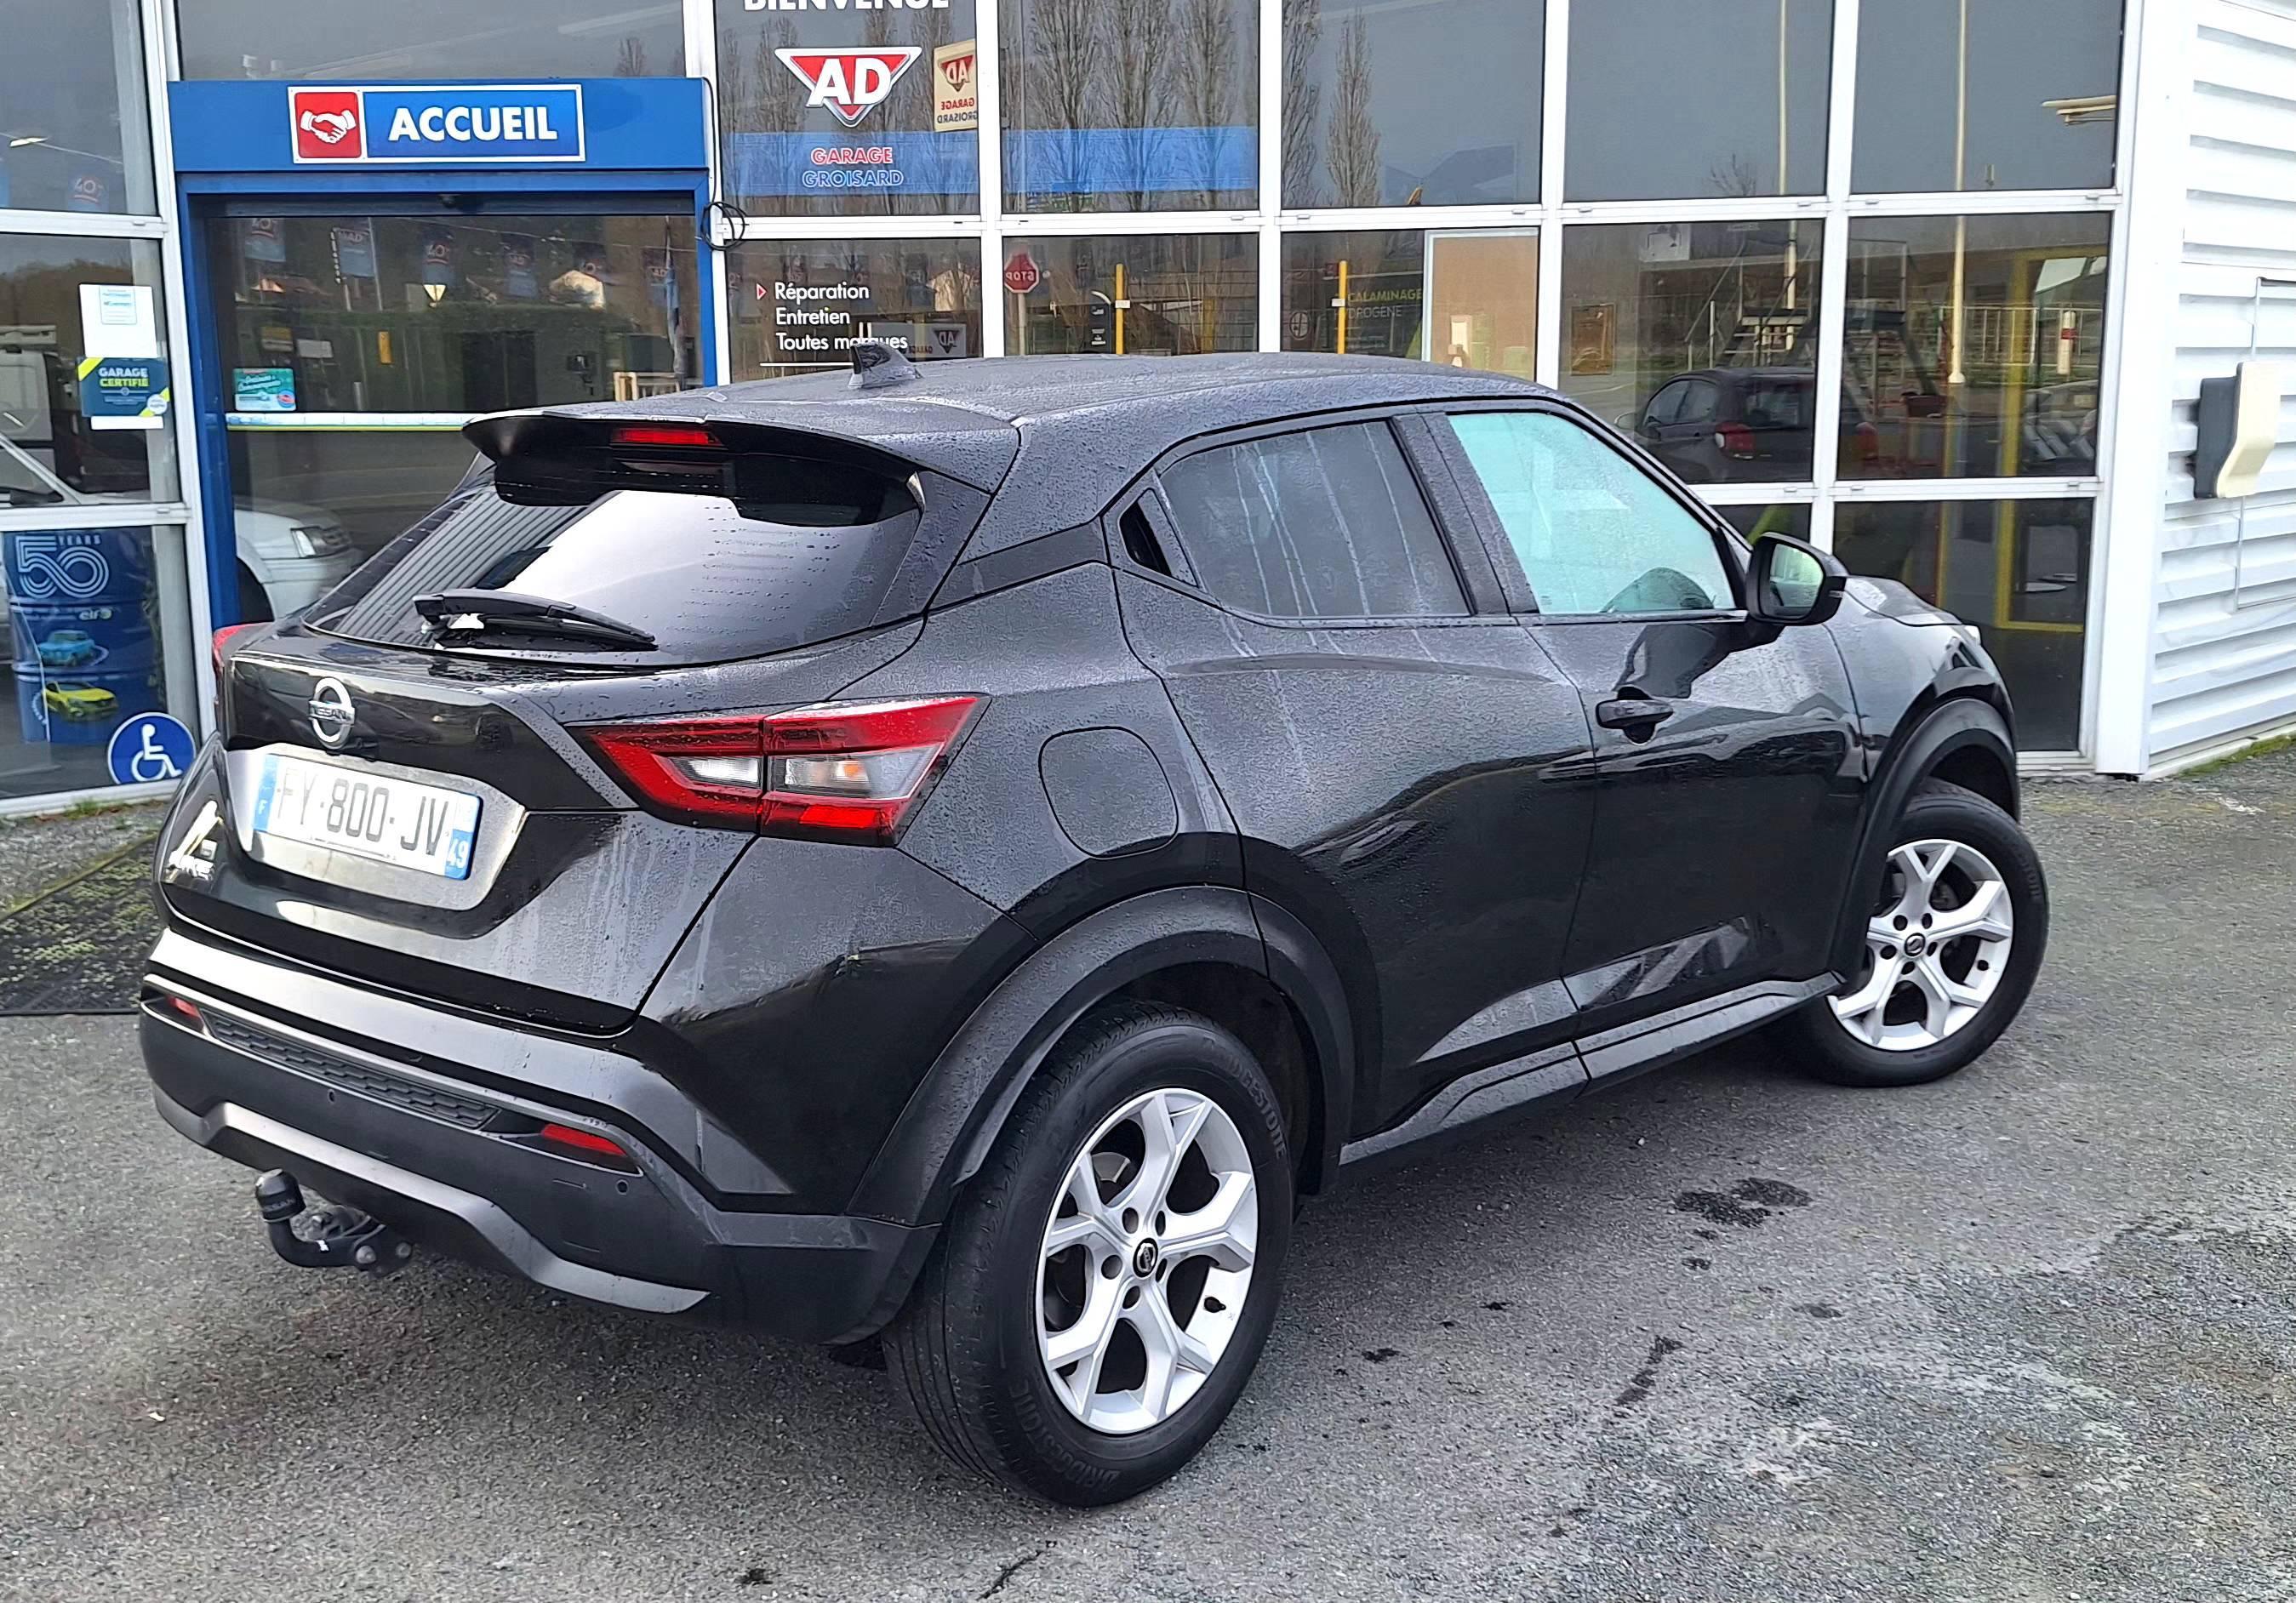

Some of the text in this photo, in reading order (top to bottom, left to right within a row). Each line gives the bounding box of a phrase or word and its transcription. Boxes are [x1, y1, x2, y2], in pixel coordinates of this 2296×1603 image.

[805, 57, 892, 106] AD
[387, 106, 557, 141] ACCUEIL
[810, 146, 894, 165] GARAGE
[802, 169, 904, 188] GROISARD
[774, 282, 870, 305] Réparation
[1334, 288, 1423, 303] CALAMINAGE
[775, 307, 850, 325] Entretien
[775, 333, 829, 351] Toutes
[99, 367, 149, 378] GARAGE
[15, 535, 110, 599] 50
[447, 837, 469, 869] 49
